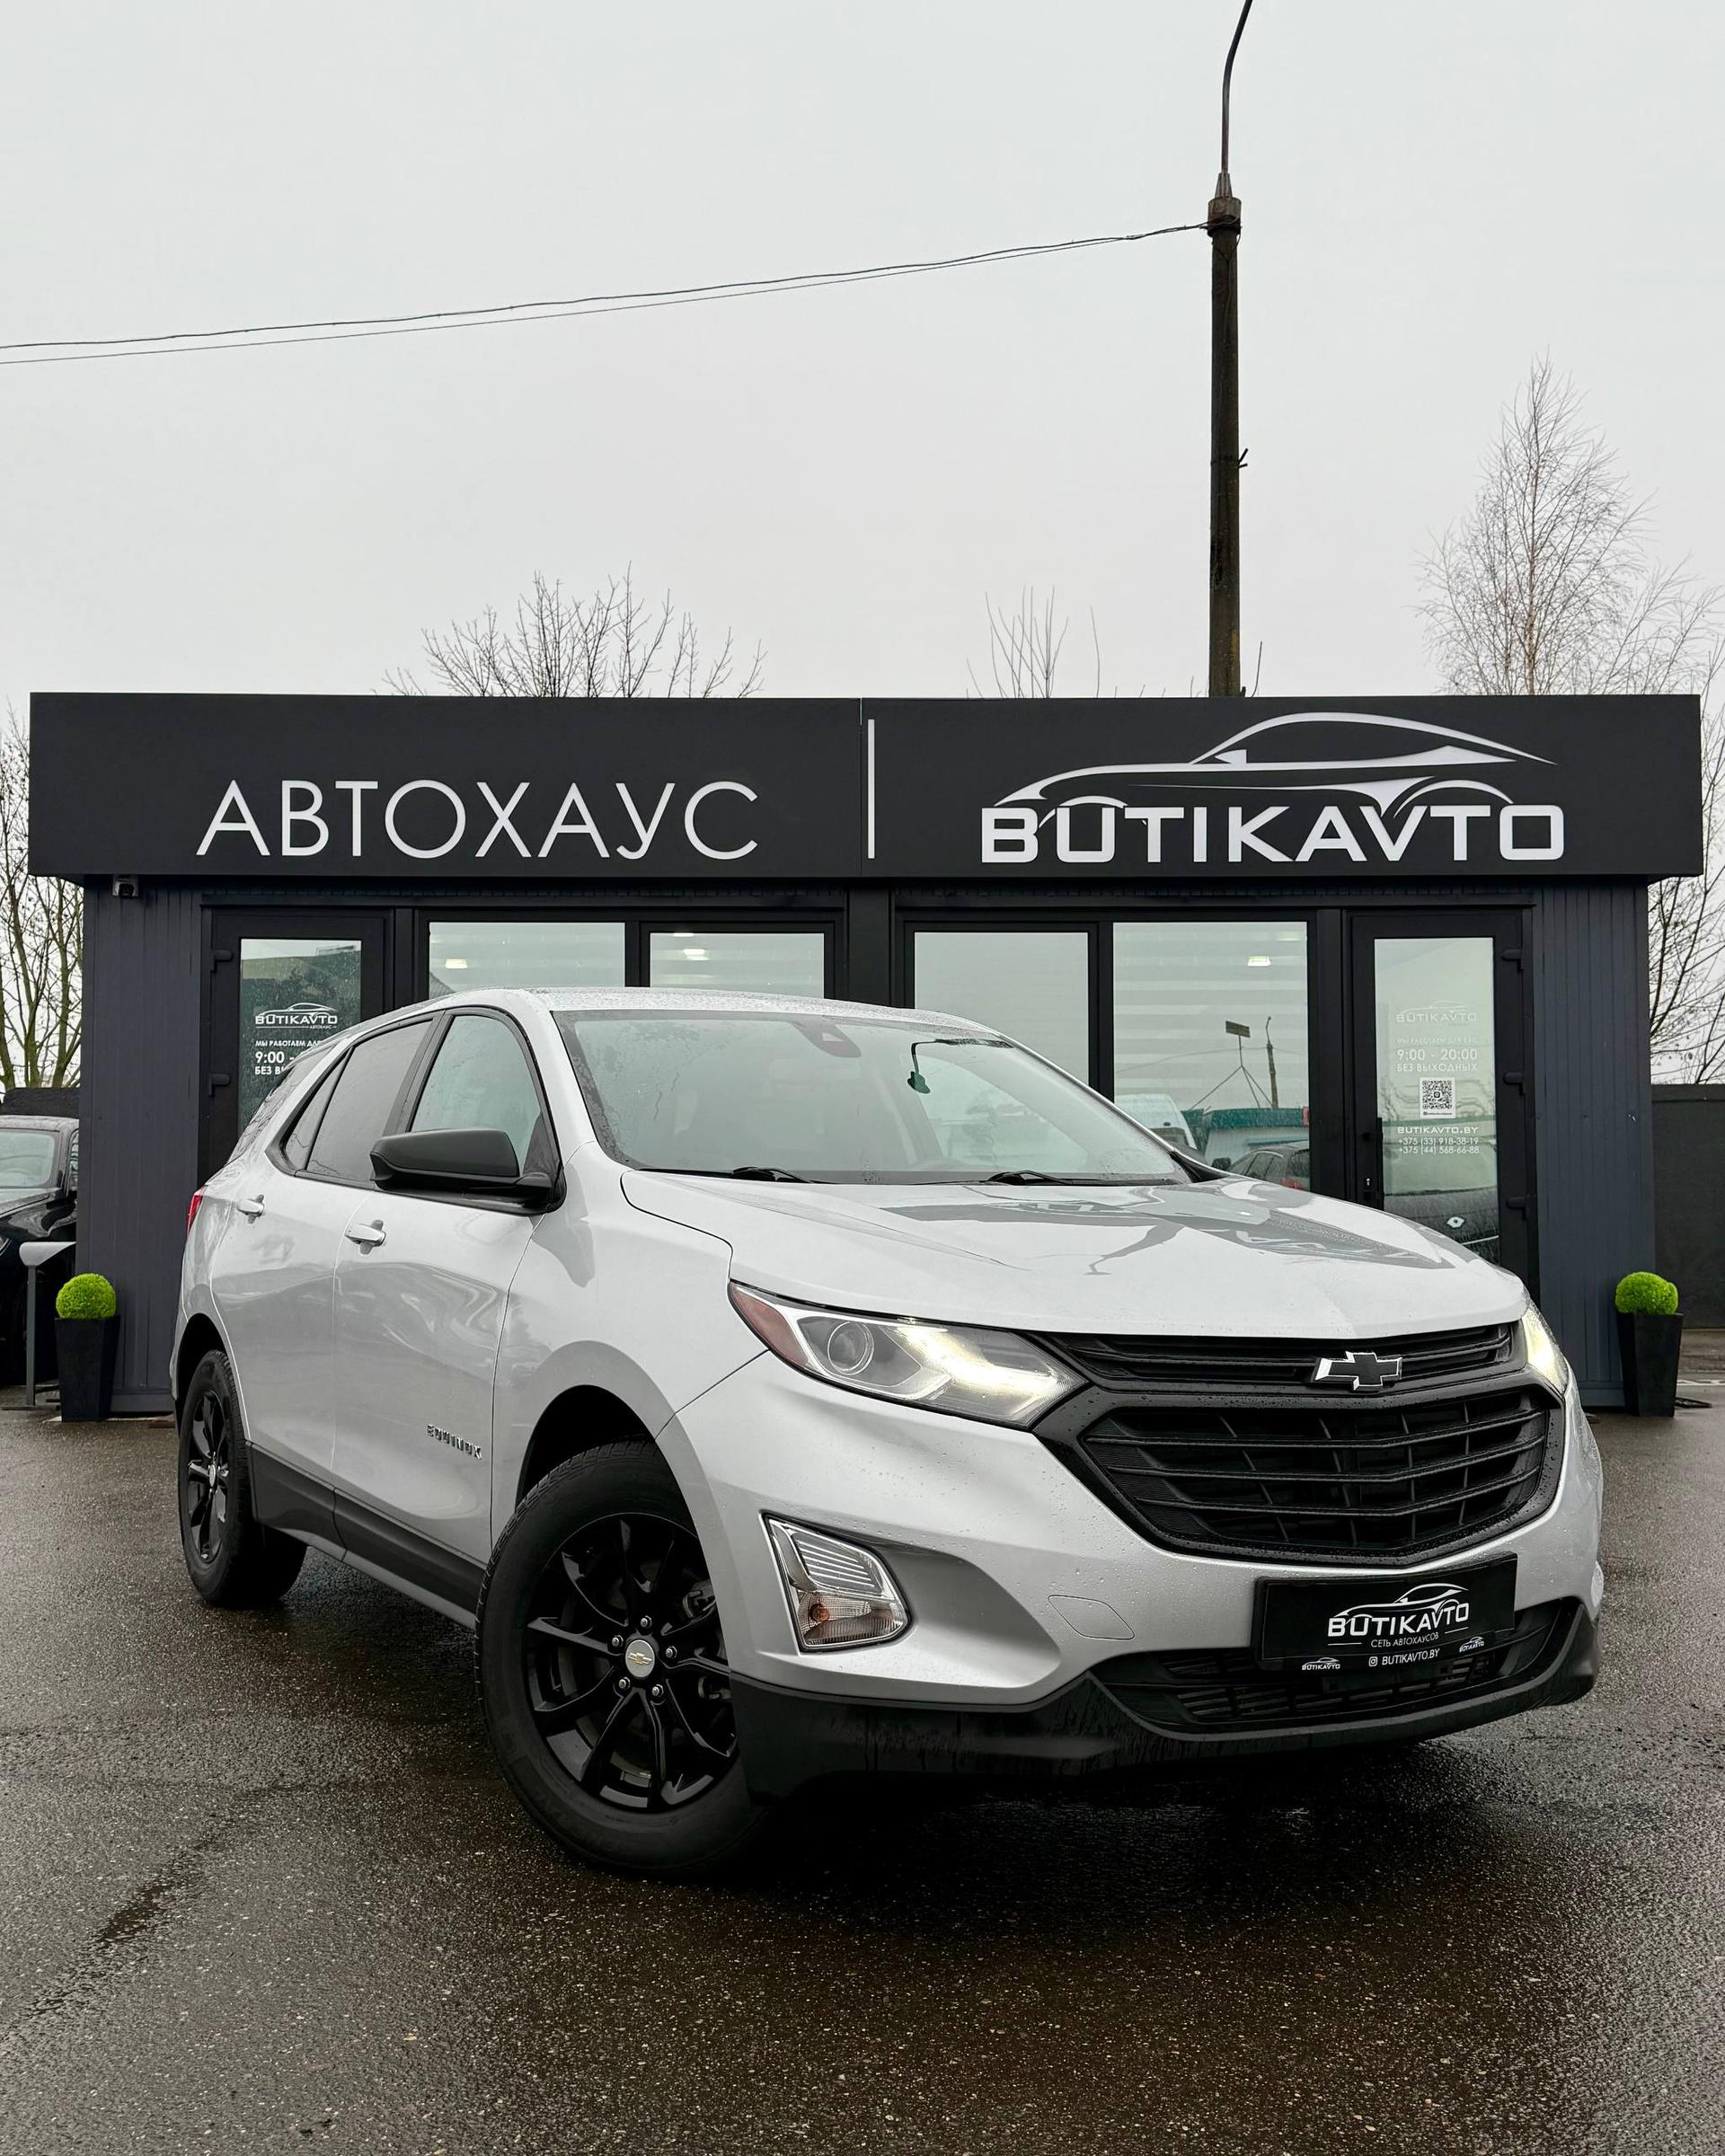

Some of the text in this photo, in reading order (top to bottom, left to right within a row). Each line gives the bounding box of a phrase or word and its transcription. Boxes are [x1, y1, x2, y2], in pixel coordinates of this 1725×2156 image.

[196, 780, 758, 860] АВТОХАУС
[981, 804, 1564, 863] BUTIKAVTO
[255, 1015, 338, 1024] BUTIKAVTO
[1396, 1012, 1477, 1022] BUTIKAVTO
[255, 1051, 285, 1064] 9:00
[1397, 1048, 1426, 1060] 9:00
[1440, 1048, 1478, 1060] 20:00
[254, 1065, 272, 1075] БЕЗ
[1397, 1063, 1478, 1072] БЕЗ ВЫХОДНЫХ
[1398, 1137, 1479, 1146] +375 (33) 918-38-19
[1399, 1146, 1480, 1155] +375 (44) 568-66-88
[1327, 1602, 1470, 1637] BUTIKAVTO
[1370, 1631, 1439, 1648] СЕТЬ АВТОХАУСОВ
[1382, 1648, 1440, 1666] BUTIKAVTO.BY
[1302, 1663, 1340, 1671] BUTIKAVTO
